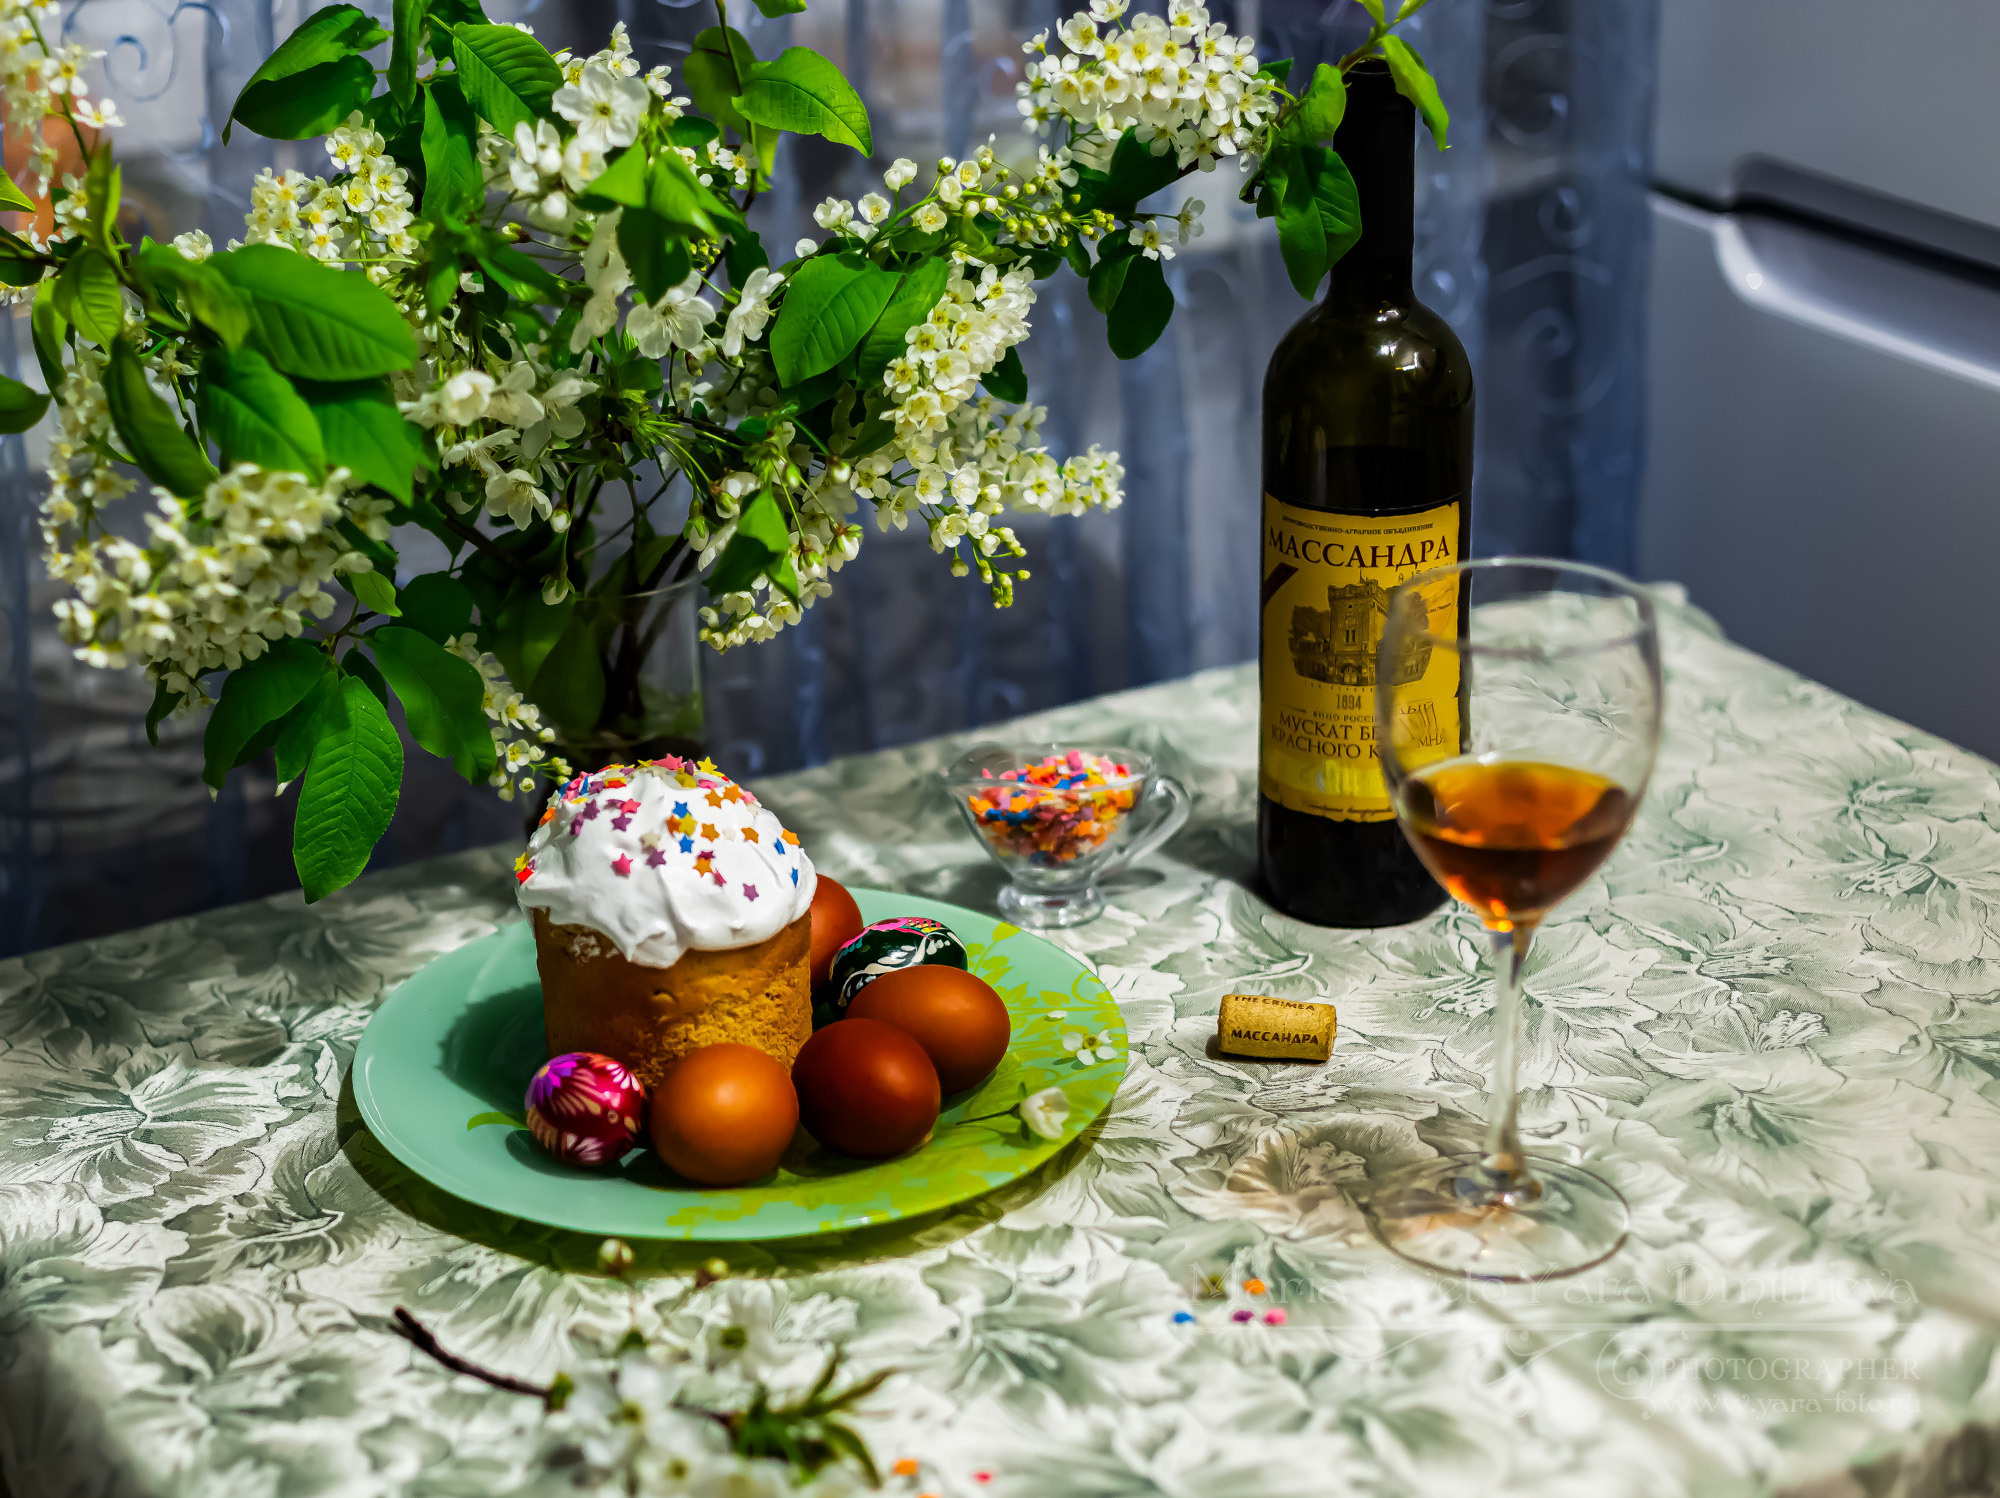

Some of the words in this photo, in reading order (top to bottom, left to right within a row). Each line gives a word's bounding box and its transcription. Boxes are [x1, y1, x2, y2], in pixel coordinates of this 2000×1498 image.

[1268, 526, 1451, 572] МАССАНДРА
[1336, 694, 1362, 710] 1894
[1312, 710, 1340, 721] ВИНО
[1343, 714, 1375, 723] РОСС
[1279, 712, 1352, 741] МУСКАТ
[1271, 725, 1361, 759] КРАСНОГО
[1261, 998, 1315, 1011] CRIMEA
[1231, 1029, 1319, 1045] МАССАНДРА
